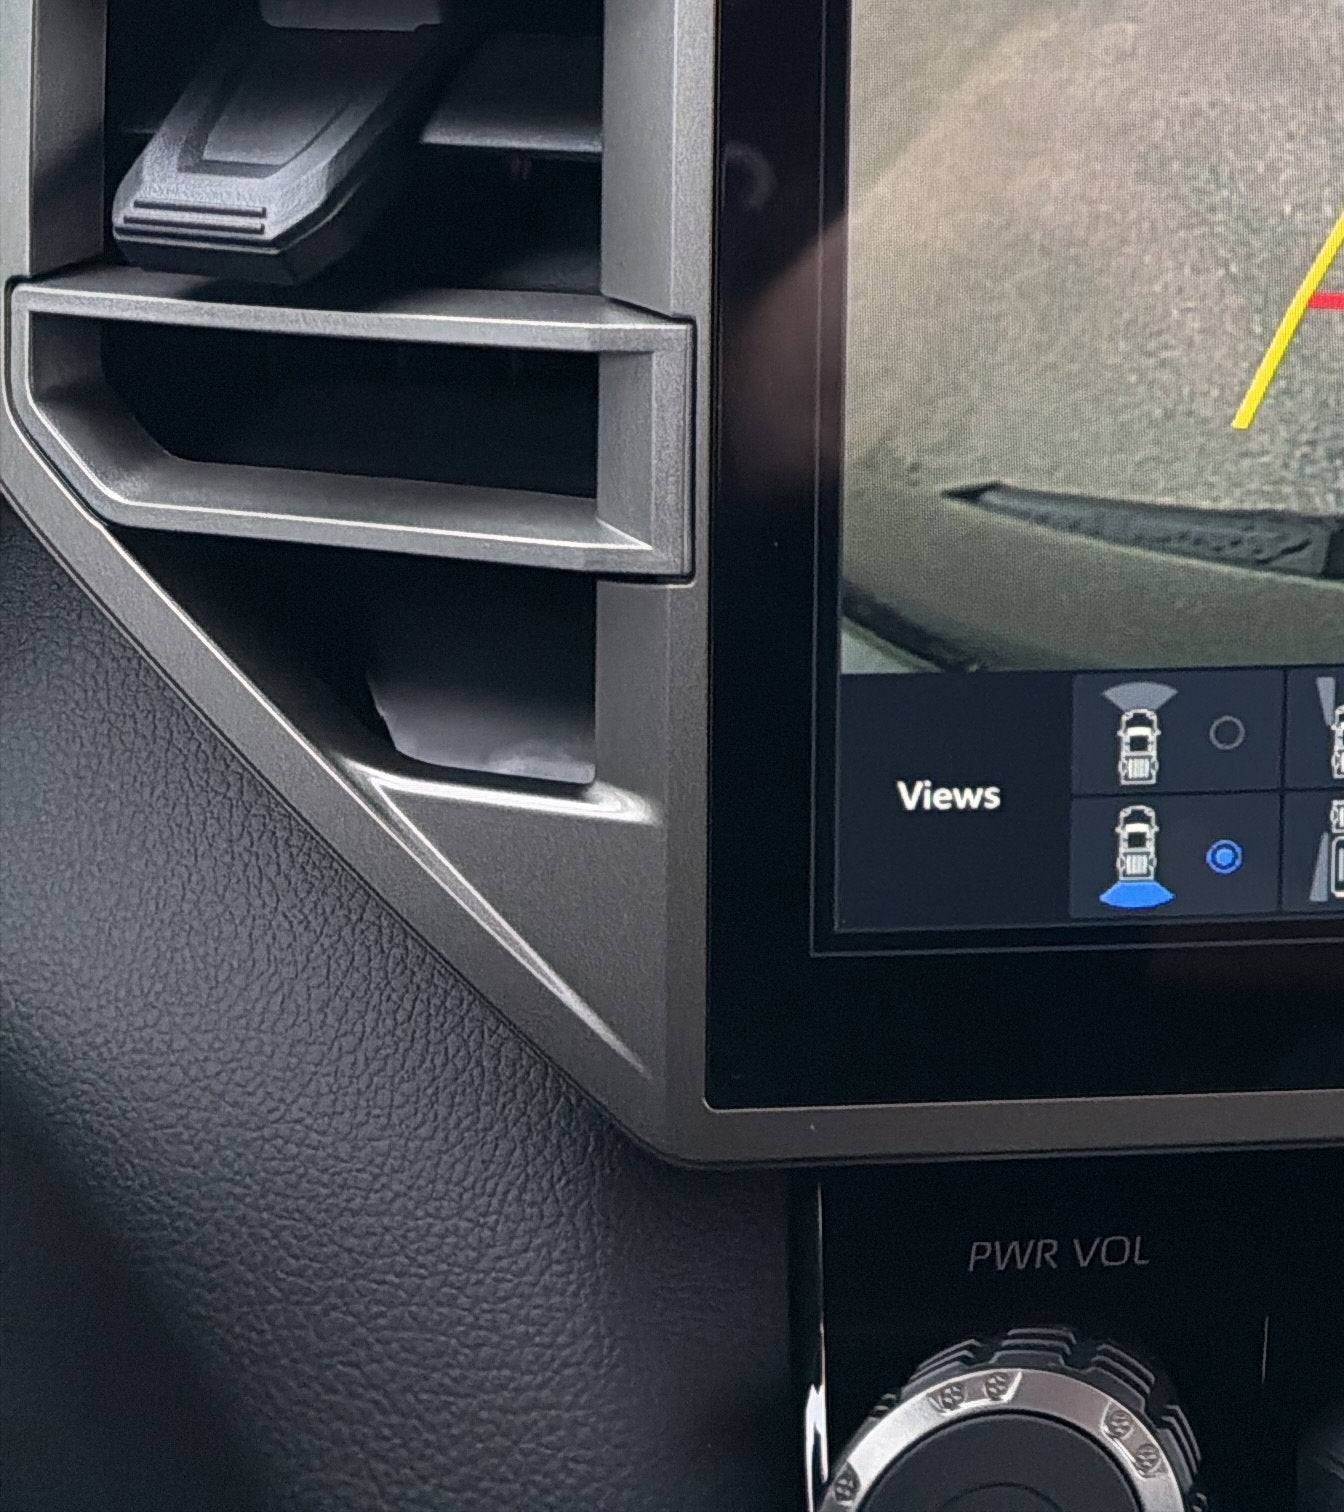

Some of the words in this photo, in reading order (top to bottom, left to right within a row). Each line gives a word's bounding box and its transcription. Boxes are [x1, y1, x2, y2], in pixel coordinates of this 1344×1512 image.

[897, 779, 1002, 813] Views
[968, 1238, 1059, 1273] PWR
[1073, 1235, 1151, 1268] VOL
